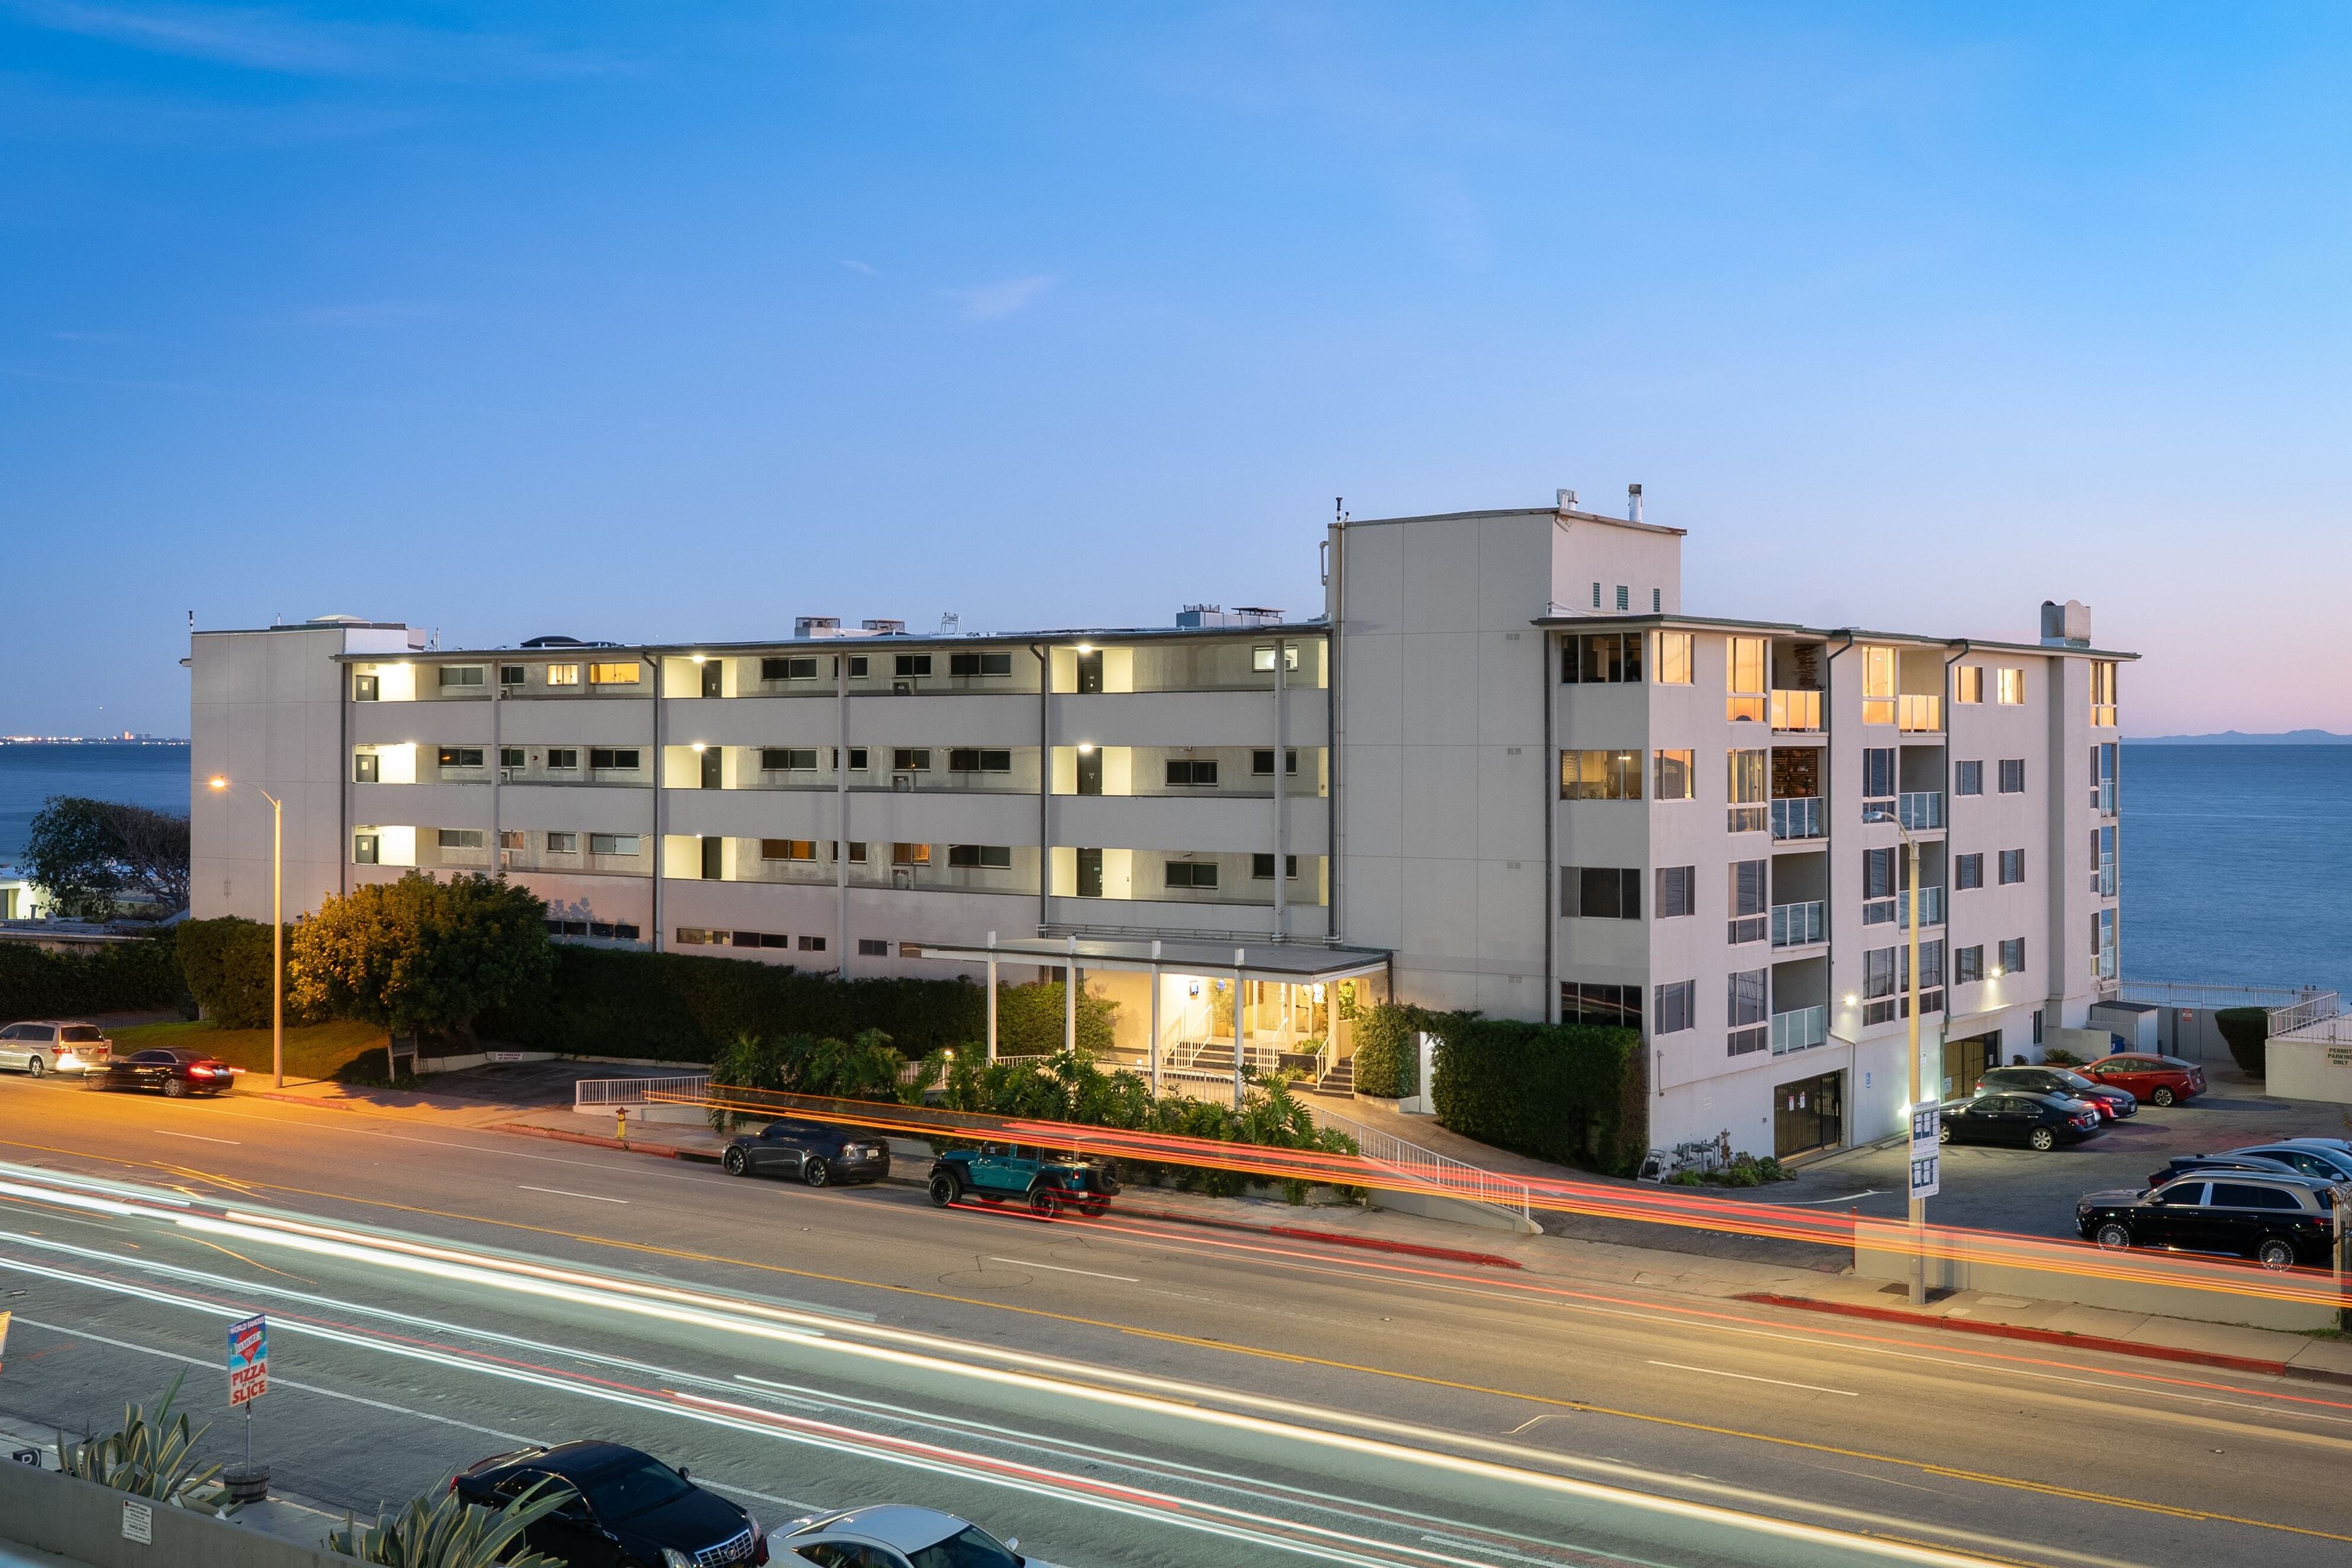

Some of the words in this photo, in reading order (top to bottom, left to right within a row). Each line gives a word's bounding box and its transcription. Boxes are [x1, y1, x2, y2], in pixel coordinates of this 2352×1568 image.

[230, 1323, 247, 1335] WORLD
[247, 1316, 265, 1329] FAMOUS
[232, 1362, 266, 1386] PIZZA
[232, 1380, 265, 1404] SLICE
